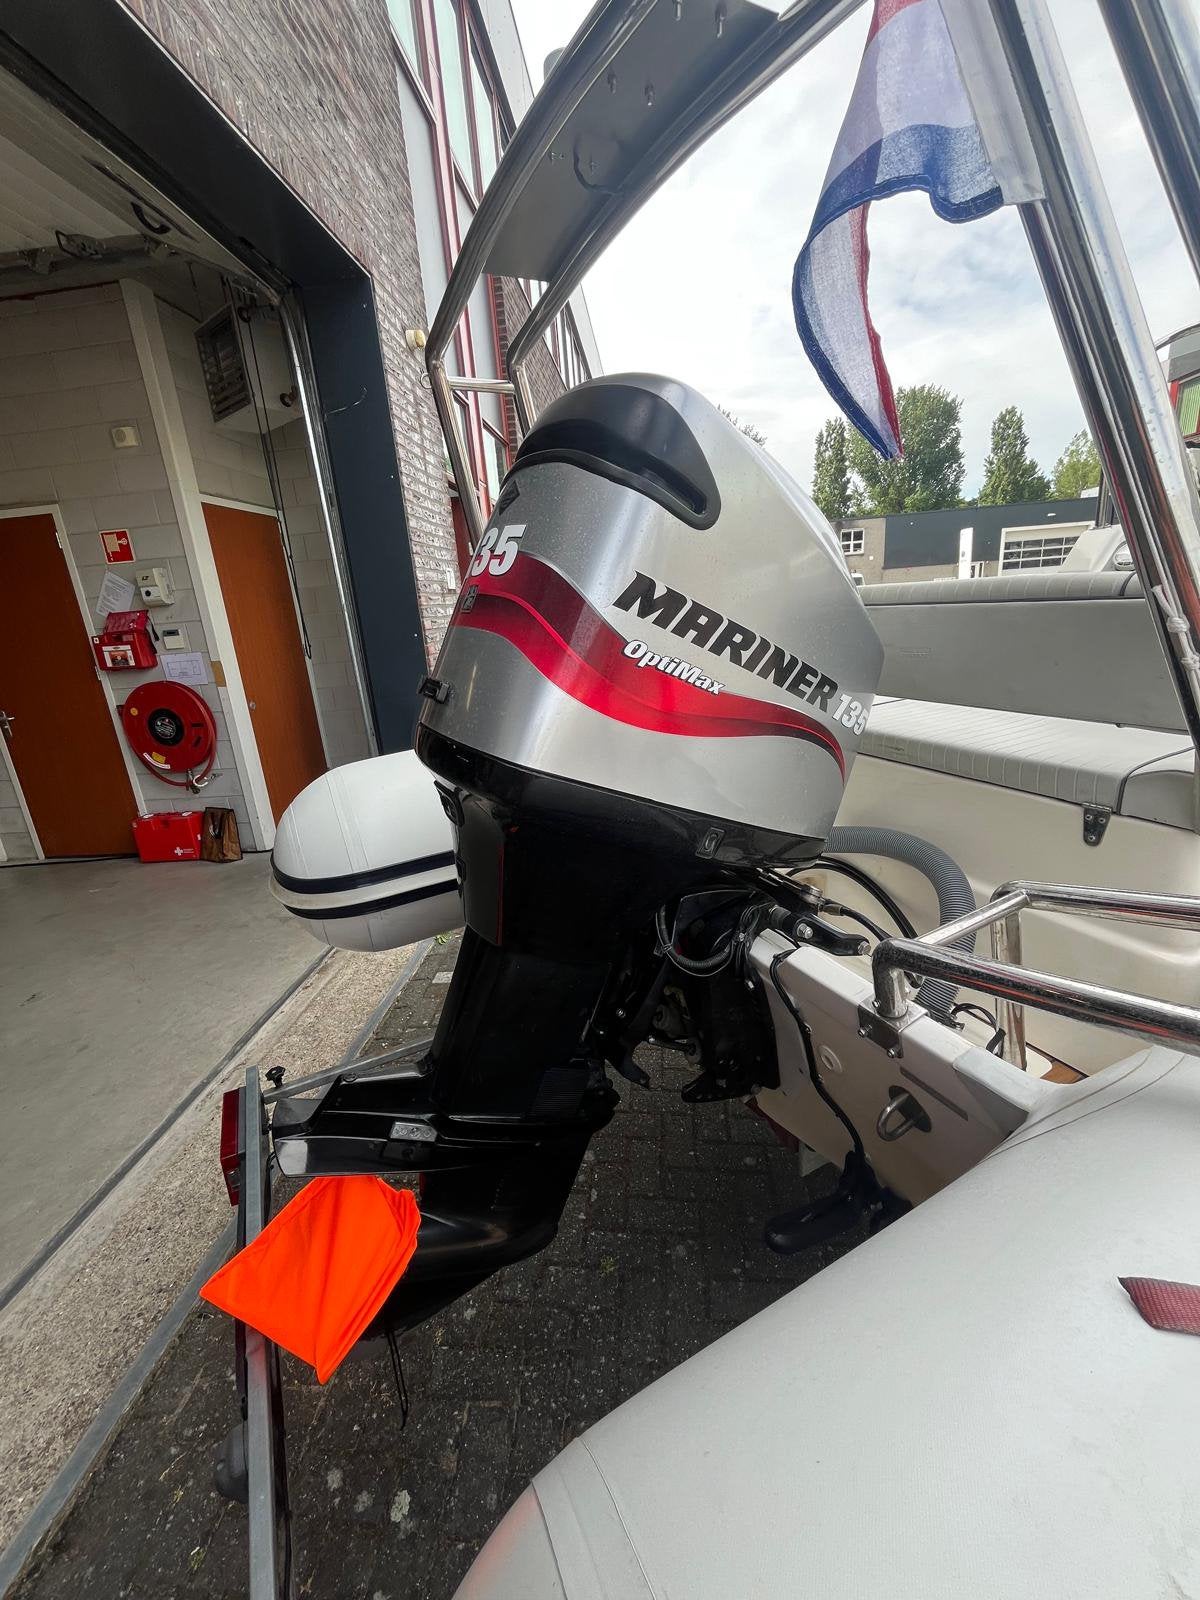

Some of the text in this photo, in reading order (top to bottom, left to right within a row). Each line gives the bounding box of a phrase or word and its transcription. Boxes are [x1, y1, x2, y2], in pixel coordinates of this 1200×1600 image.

[612, 570, 869, 736] MARINER 135
[622, 639, 726, 695] OptiMax
